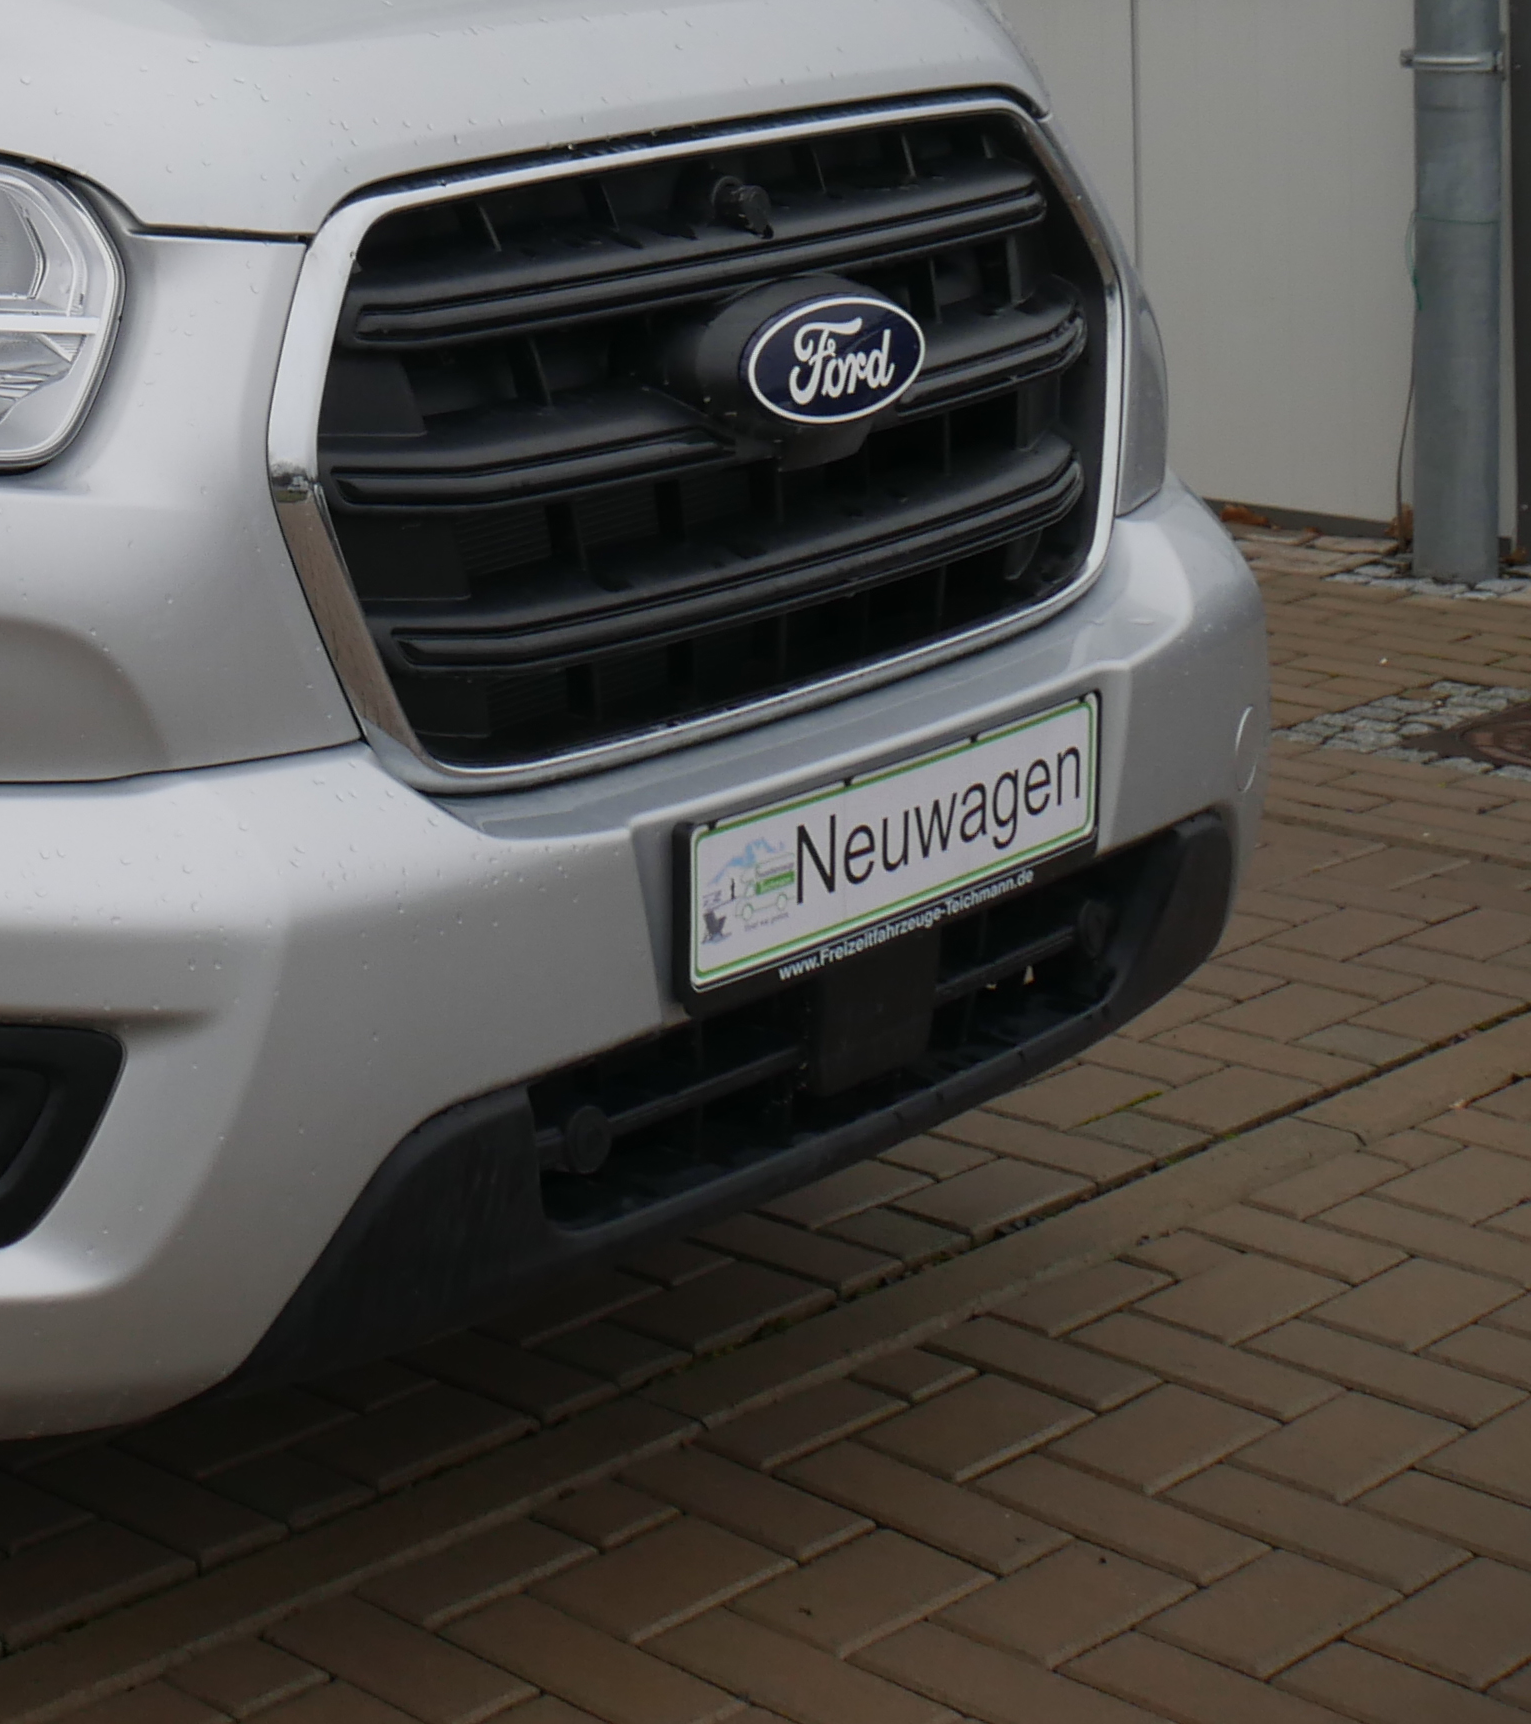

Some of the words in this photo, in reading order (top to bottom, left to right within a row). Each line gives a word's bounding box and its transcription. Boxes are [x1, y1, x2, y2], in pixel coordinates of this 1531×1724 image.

[789, 317, 895, 405] Ford
[796, 745, 1081, 905] Neuwagen
[778, 870, 1034, 981] www.Freizeitfahrzeuge-Teichmann.de
